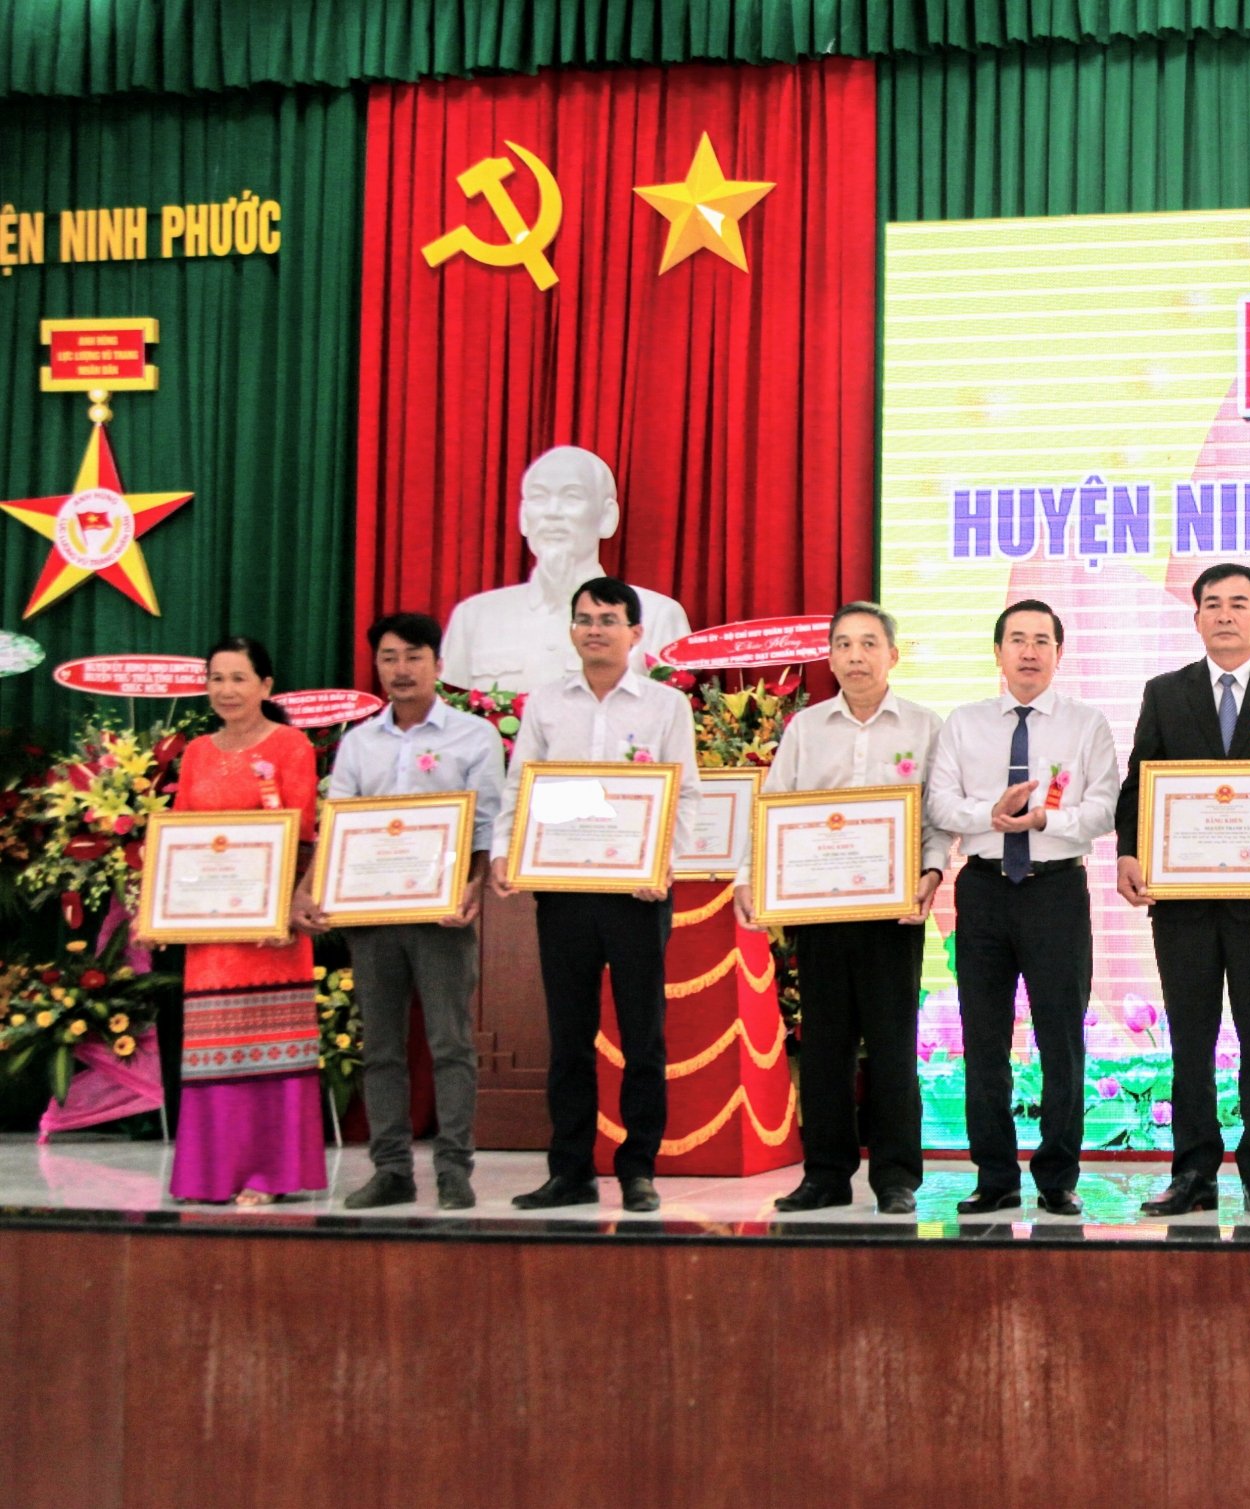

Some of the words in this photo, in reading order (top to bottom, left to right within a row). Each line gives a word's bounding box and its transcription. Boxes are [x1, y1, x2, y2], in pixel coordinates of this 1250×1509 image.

[60, 207, 147, 263] NINH
[161, 189, 281, 258] PHƯỚC
[953, 475, 1150, 567] HUYỆN
